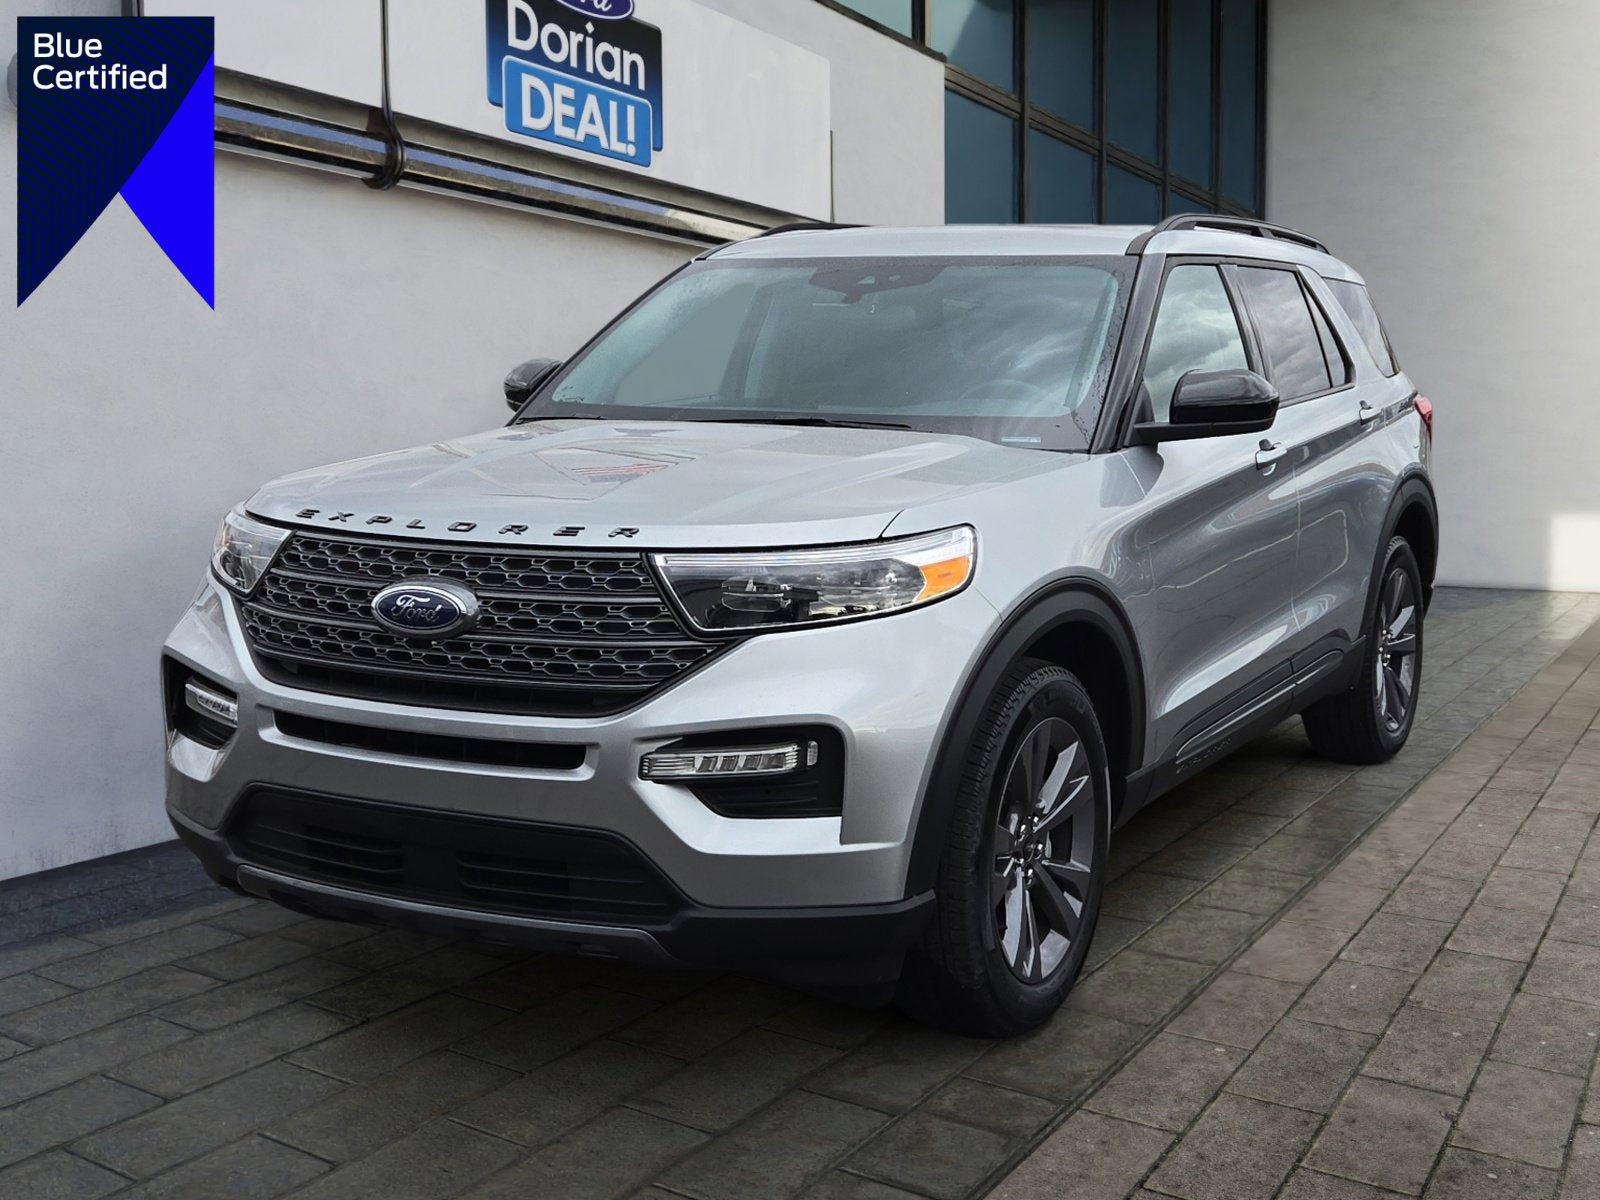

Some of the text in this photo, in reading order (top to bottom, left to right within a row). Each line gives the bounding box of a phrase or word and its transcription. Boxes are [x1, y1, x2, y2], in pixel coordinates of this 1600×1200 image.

[507, 0, 645, 91] Dorian
[521, 72, 636, 157] DEAL!
[295, 508, 640, 538] EXPLORER
[391, 594, 442, 622] Ford
